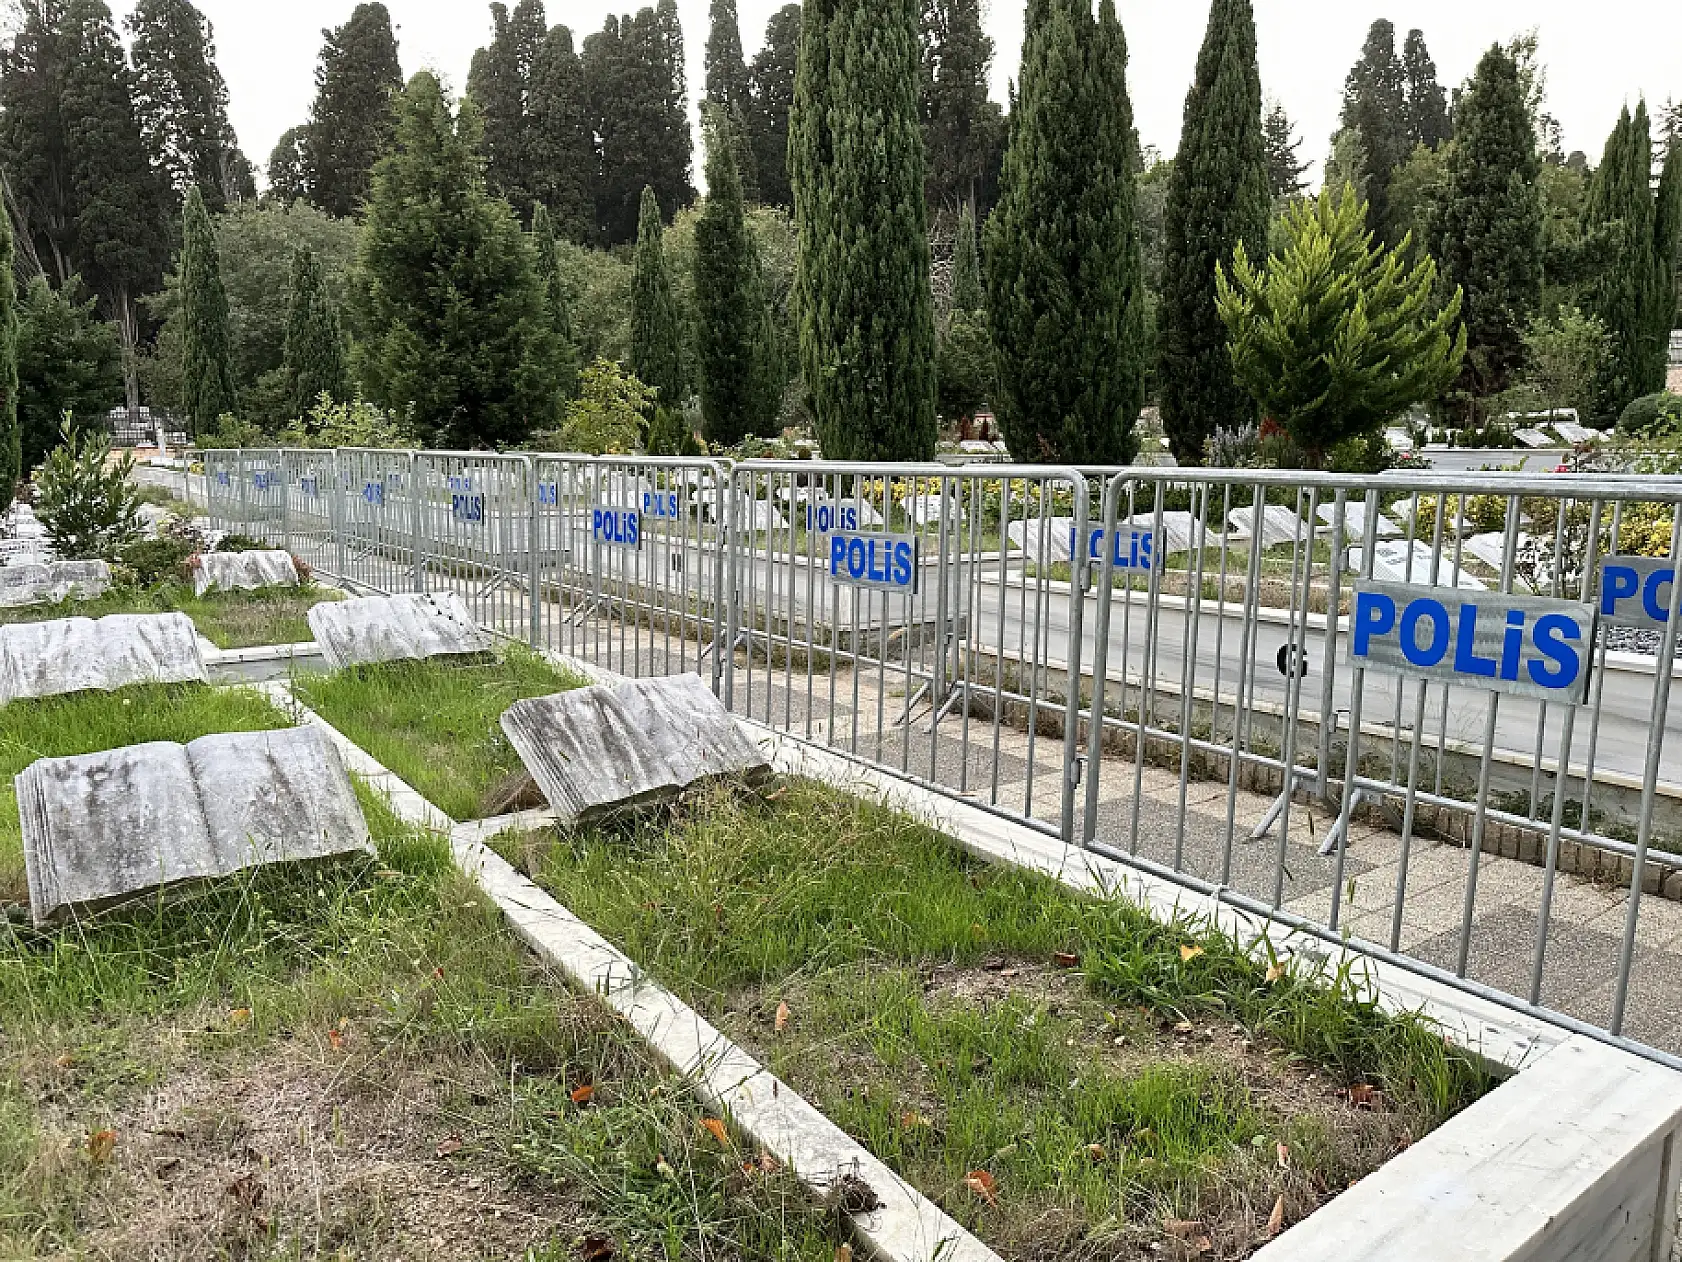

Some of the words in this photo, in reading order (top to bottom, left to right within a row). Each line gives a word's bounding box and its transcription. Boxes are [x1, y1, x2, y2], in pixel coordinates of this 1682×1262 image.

[594, 510, 637, 544] POLiS
[831, 536, 912, 585] POLiS
[1353, 592, 1582, 689] POLiS
